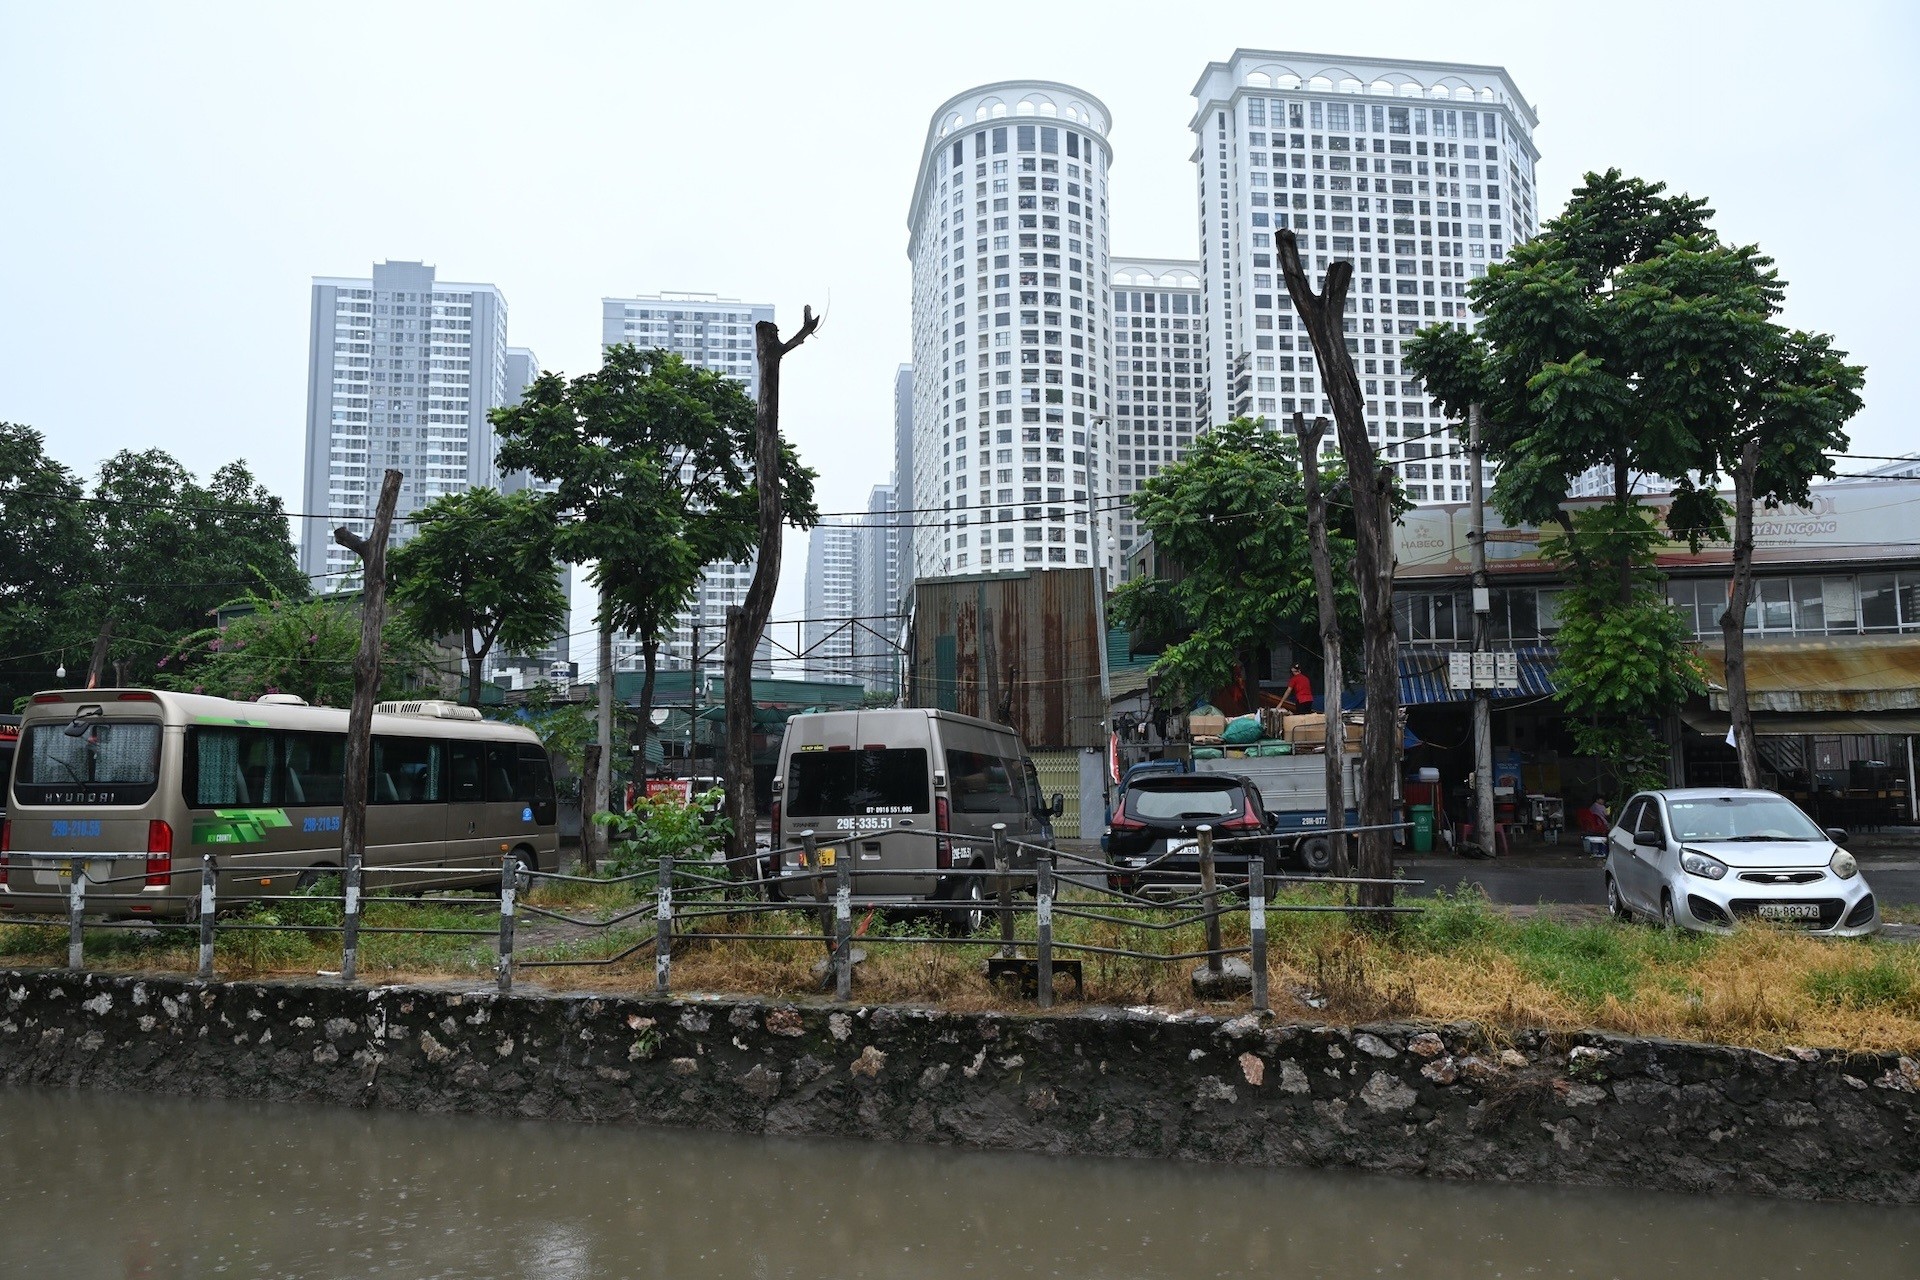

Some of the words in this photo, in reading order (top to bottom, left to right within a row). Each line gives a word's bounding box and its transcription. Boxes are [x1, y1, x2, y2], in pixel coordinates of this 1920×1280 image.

[1785, 521, 1836, 536] NGỌNG
[1401, 539, 1444, 549] HABECO
[45, 792, 115, 802] HYUNDAI
[837, 817, 892, 829] 29E-335.51
